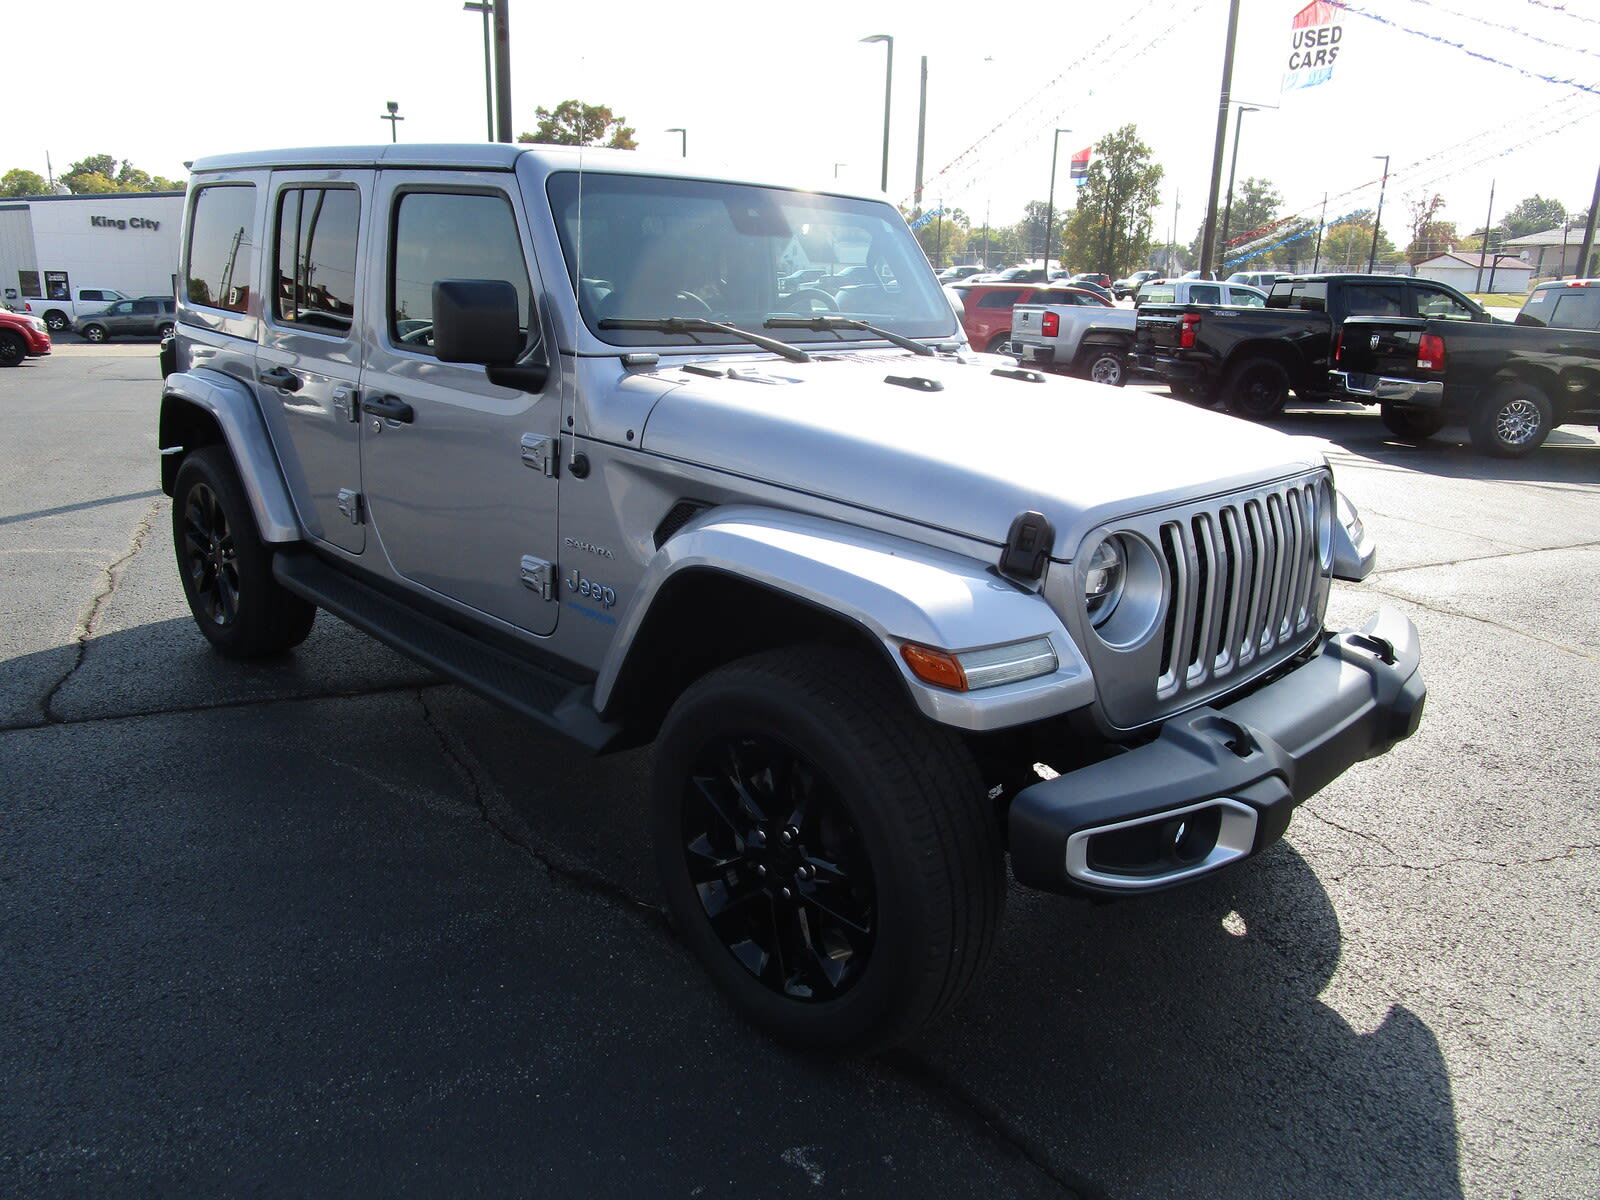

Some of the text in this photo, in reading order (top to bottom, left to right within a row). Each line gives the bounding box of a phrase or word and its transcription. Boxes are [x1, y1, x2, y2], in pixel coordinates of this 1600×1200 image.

[1292, 25, 1342, 50] USED
[1288, 46, 1340, 70] CARS
[91, 215, 160, 231] King City
[564, 537, 616, 561] SAHARA
[565, 568, 617, 610] Jeep
